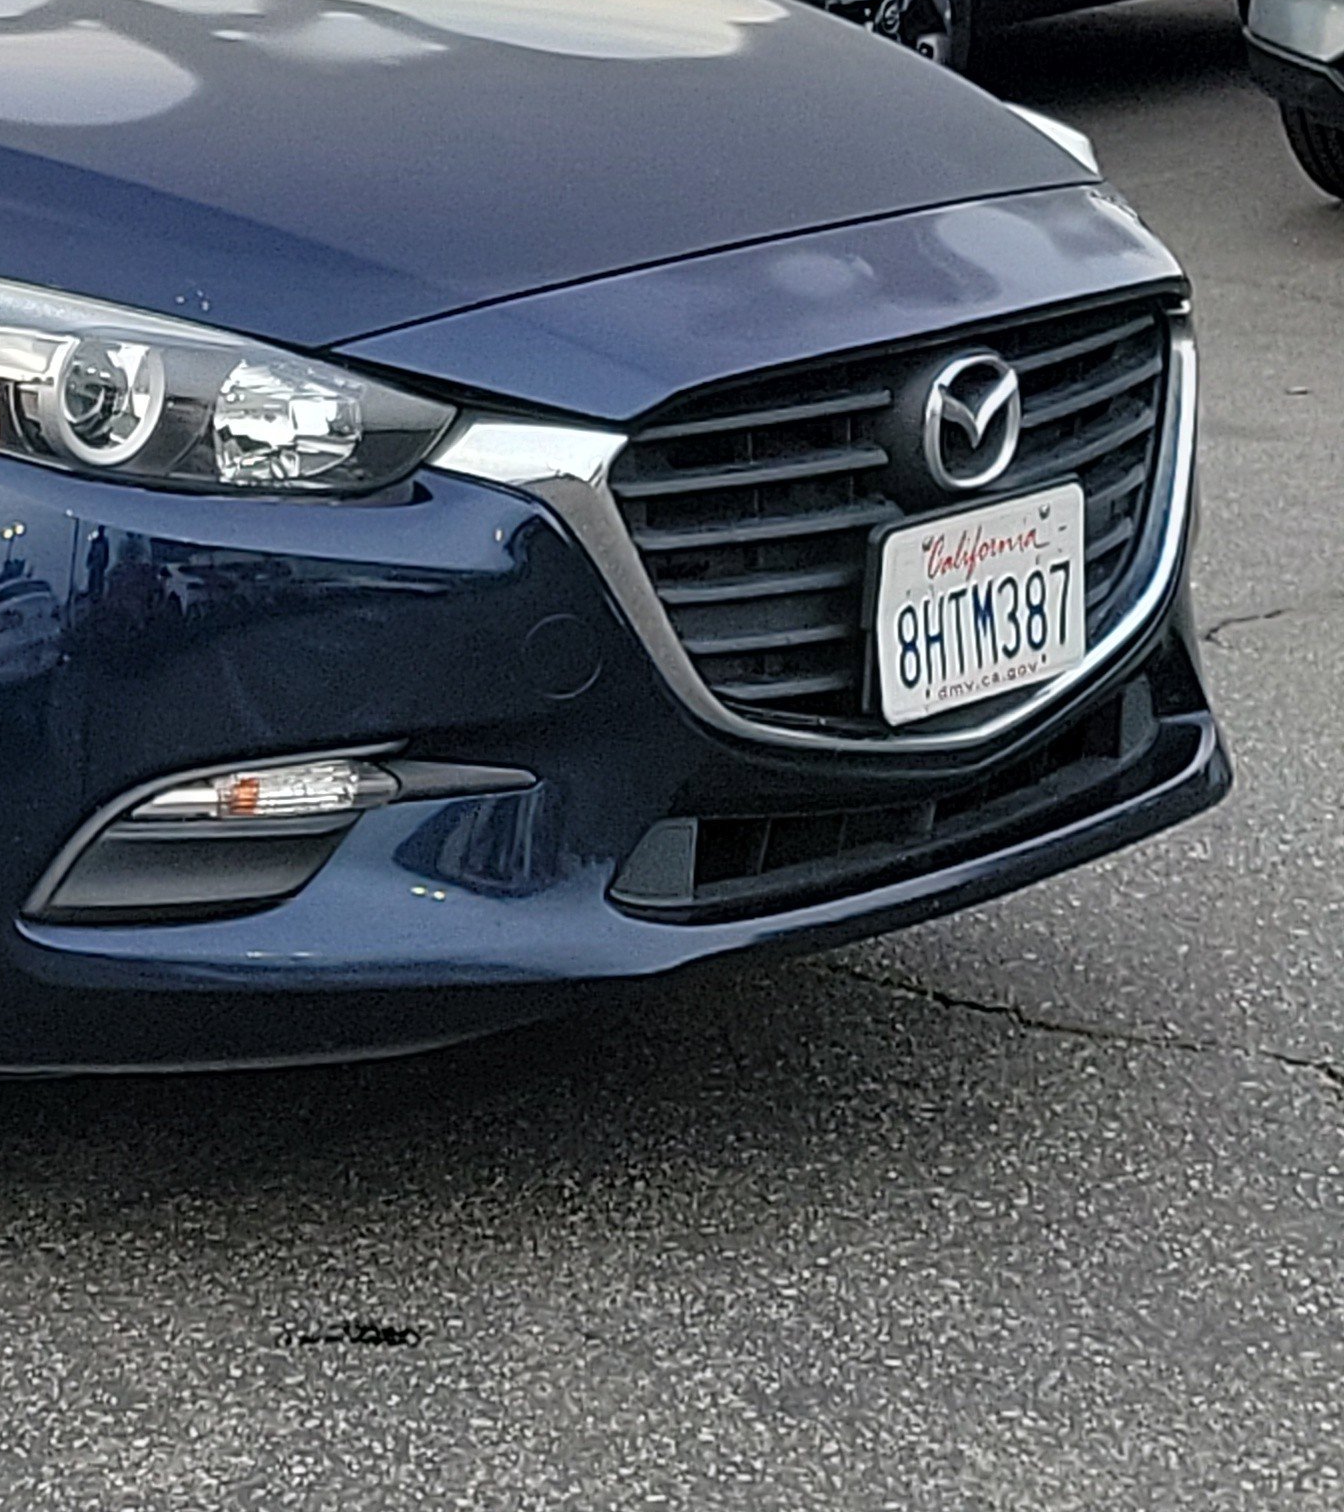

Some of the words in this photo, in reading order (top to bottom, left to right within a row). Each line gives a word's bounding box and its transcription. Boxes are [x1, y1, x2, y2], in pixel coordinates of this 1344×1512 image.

[925, 525, 1050, 581] California
[897, 560, 1071, 689] 8HTM387
[937, 662, 1040, 700] dmv.ca.gov
